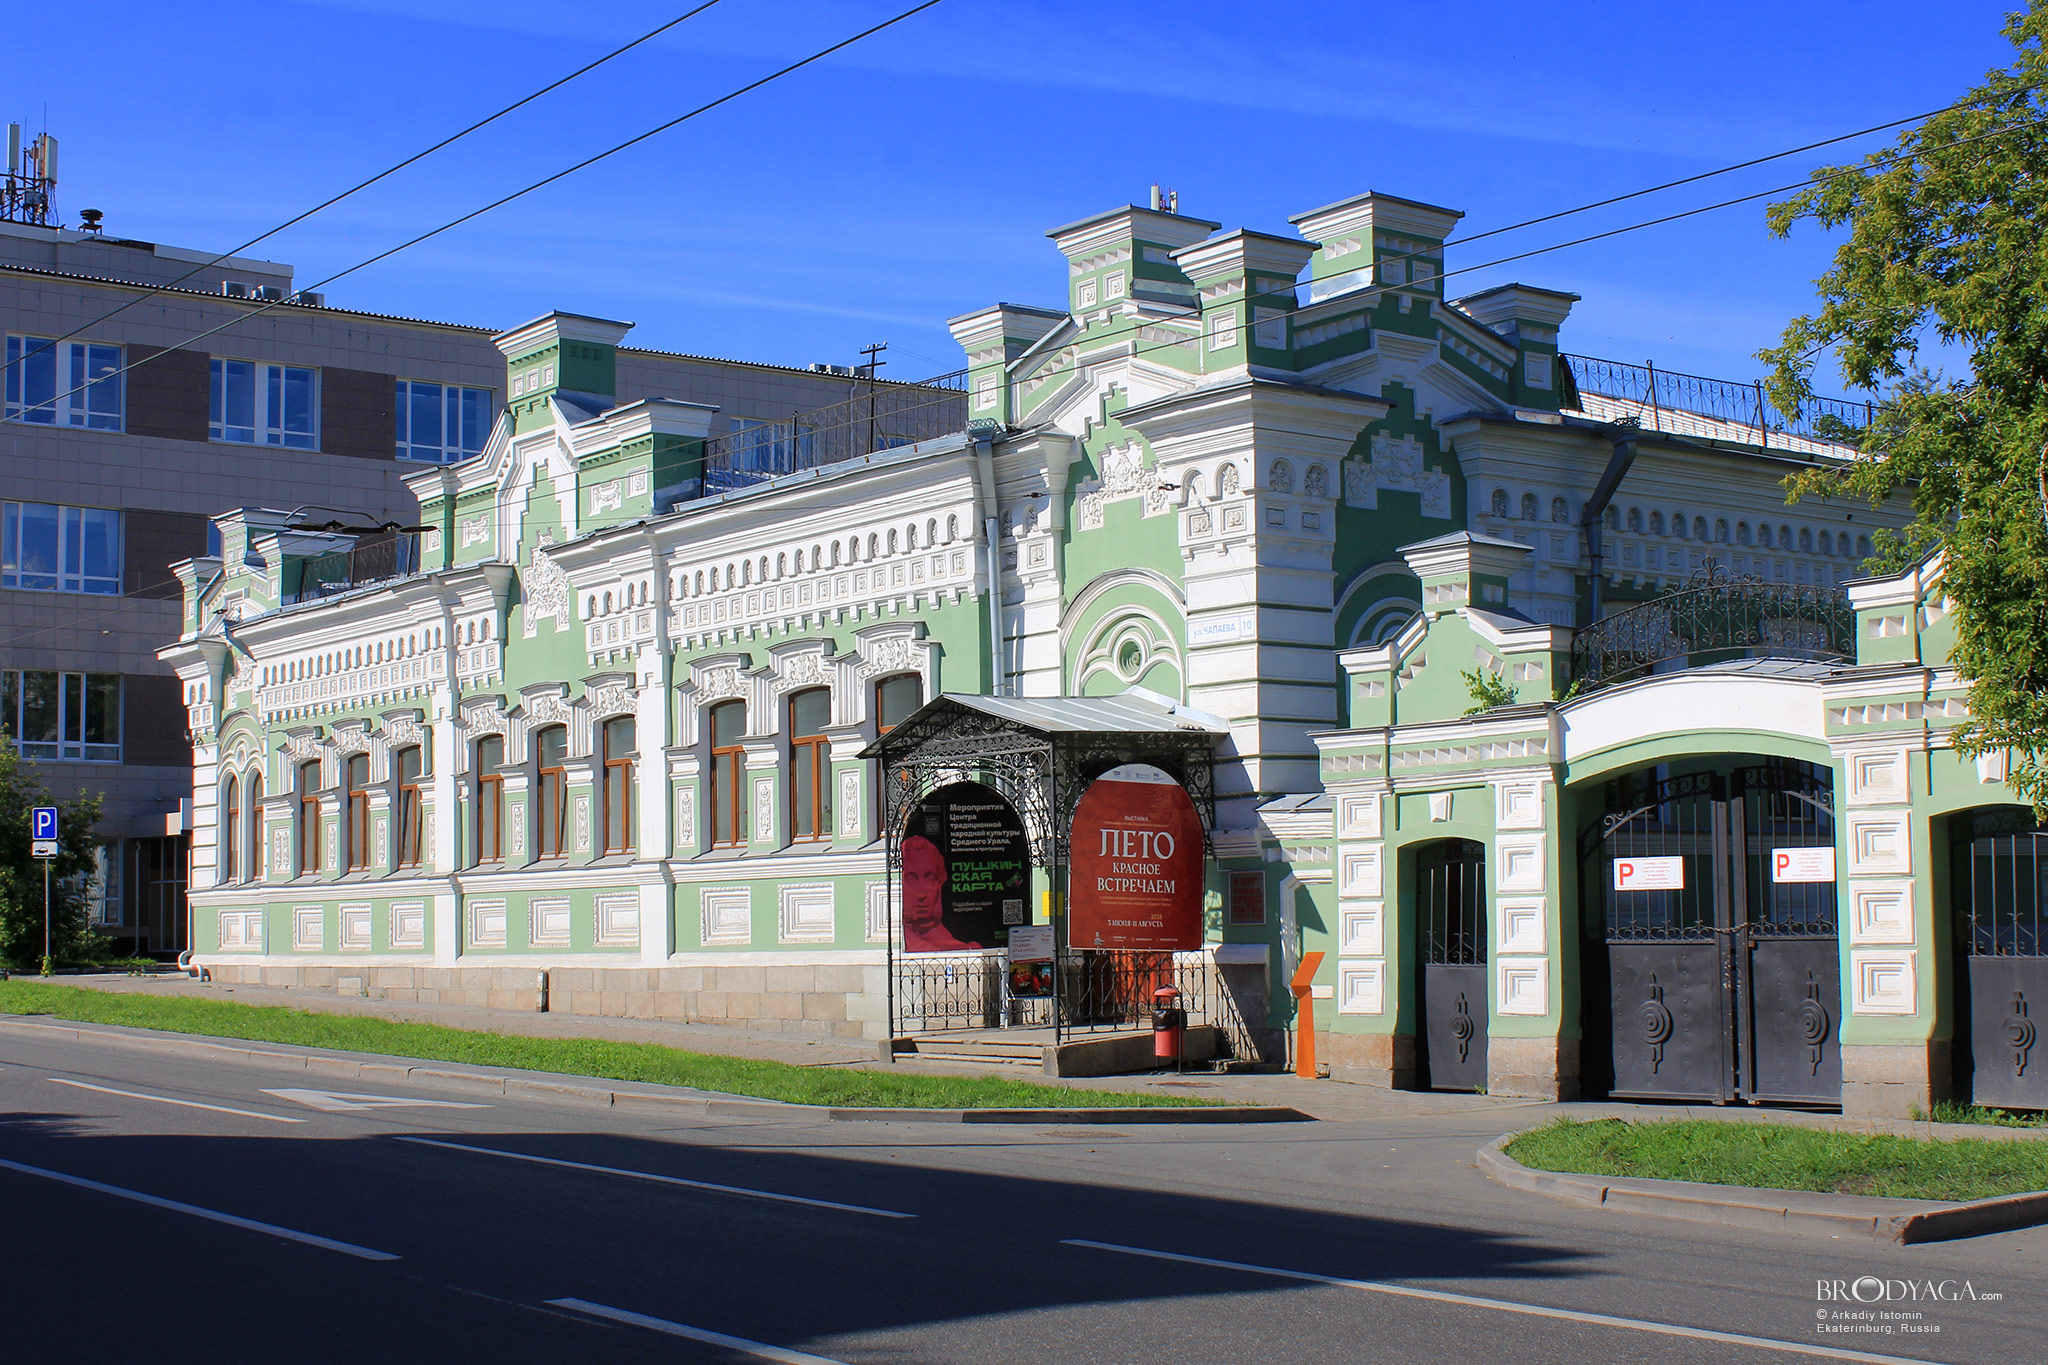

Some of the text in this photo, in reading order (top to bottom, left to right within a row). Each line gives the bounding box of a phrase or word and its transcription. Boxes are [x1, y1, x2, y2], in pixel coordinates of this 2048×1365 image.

[1193, 620, 1252, 638] ул. ЧАПАЕВА 10
[949, 804, 1004, 812] Мероприятия
[949, 814, 977, 822] Центра
[37, 811, 51, 836] P
[950, 821, 1002, 829] традиционной
[950, 830, 1020, 838] народной культуры
[951, 838, 1011, 847] Среднего Урала,
[1098, 828, 1175, 860] ЛЕТО
[951, 861, 1022, 871] ПУШКИН
[1112, 862, 1161, 875] КРАСНОЕ
[1777, 854, 1790, 877] P
[951, 871, 993, 882] СКАЯ
[1619, 863, 1634, 886] P
[952, 882, 1004, 892] КАРТА
[1097, 877, 1176, 894] ВСТРЕЧАЕМ
[1138, 920, 1164, 928] АВГУСТА
